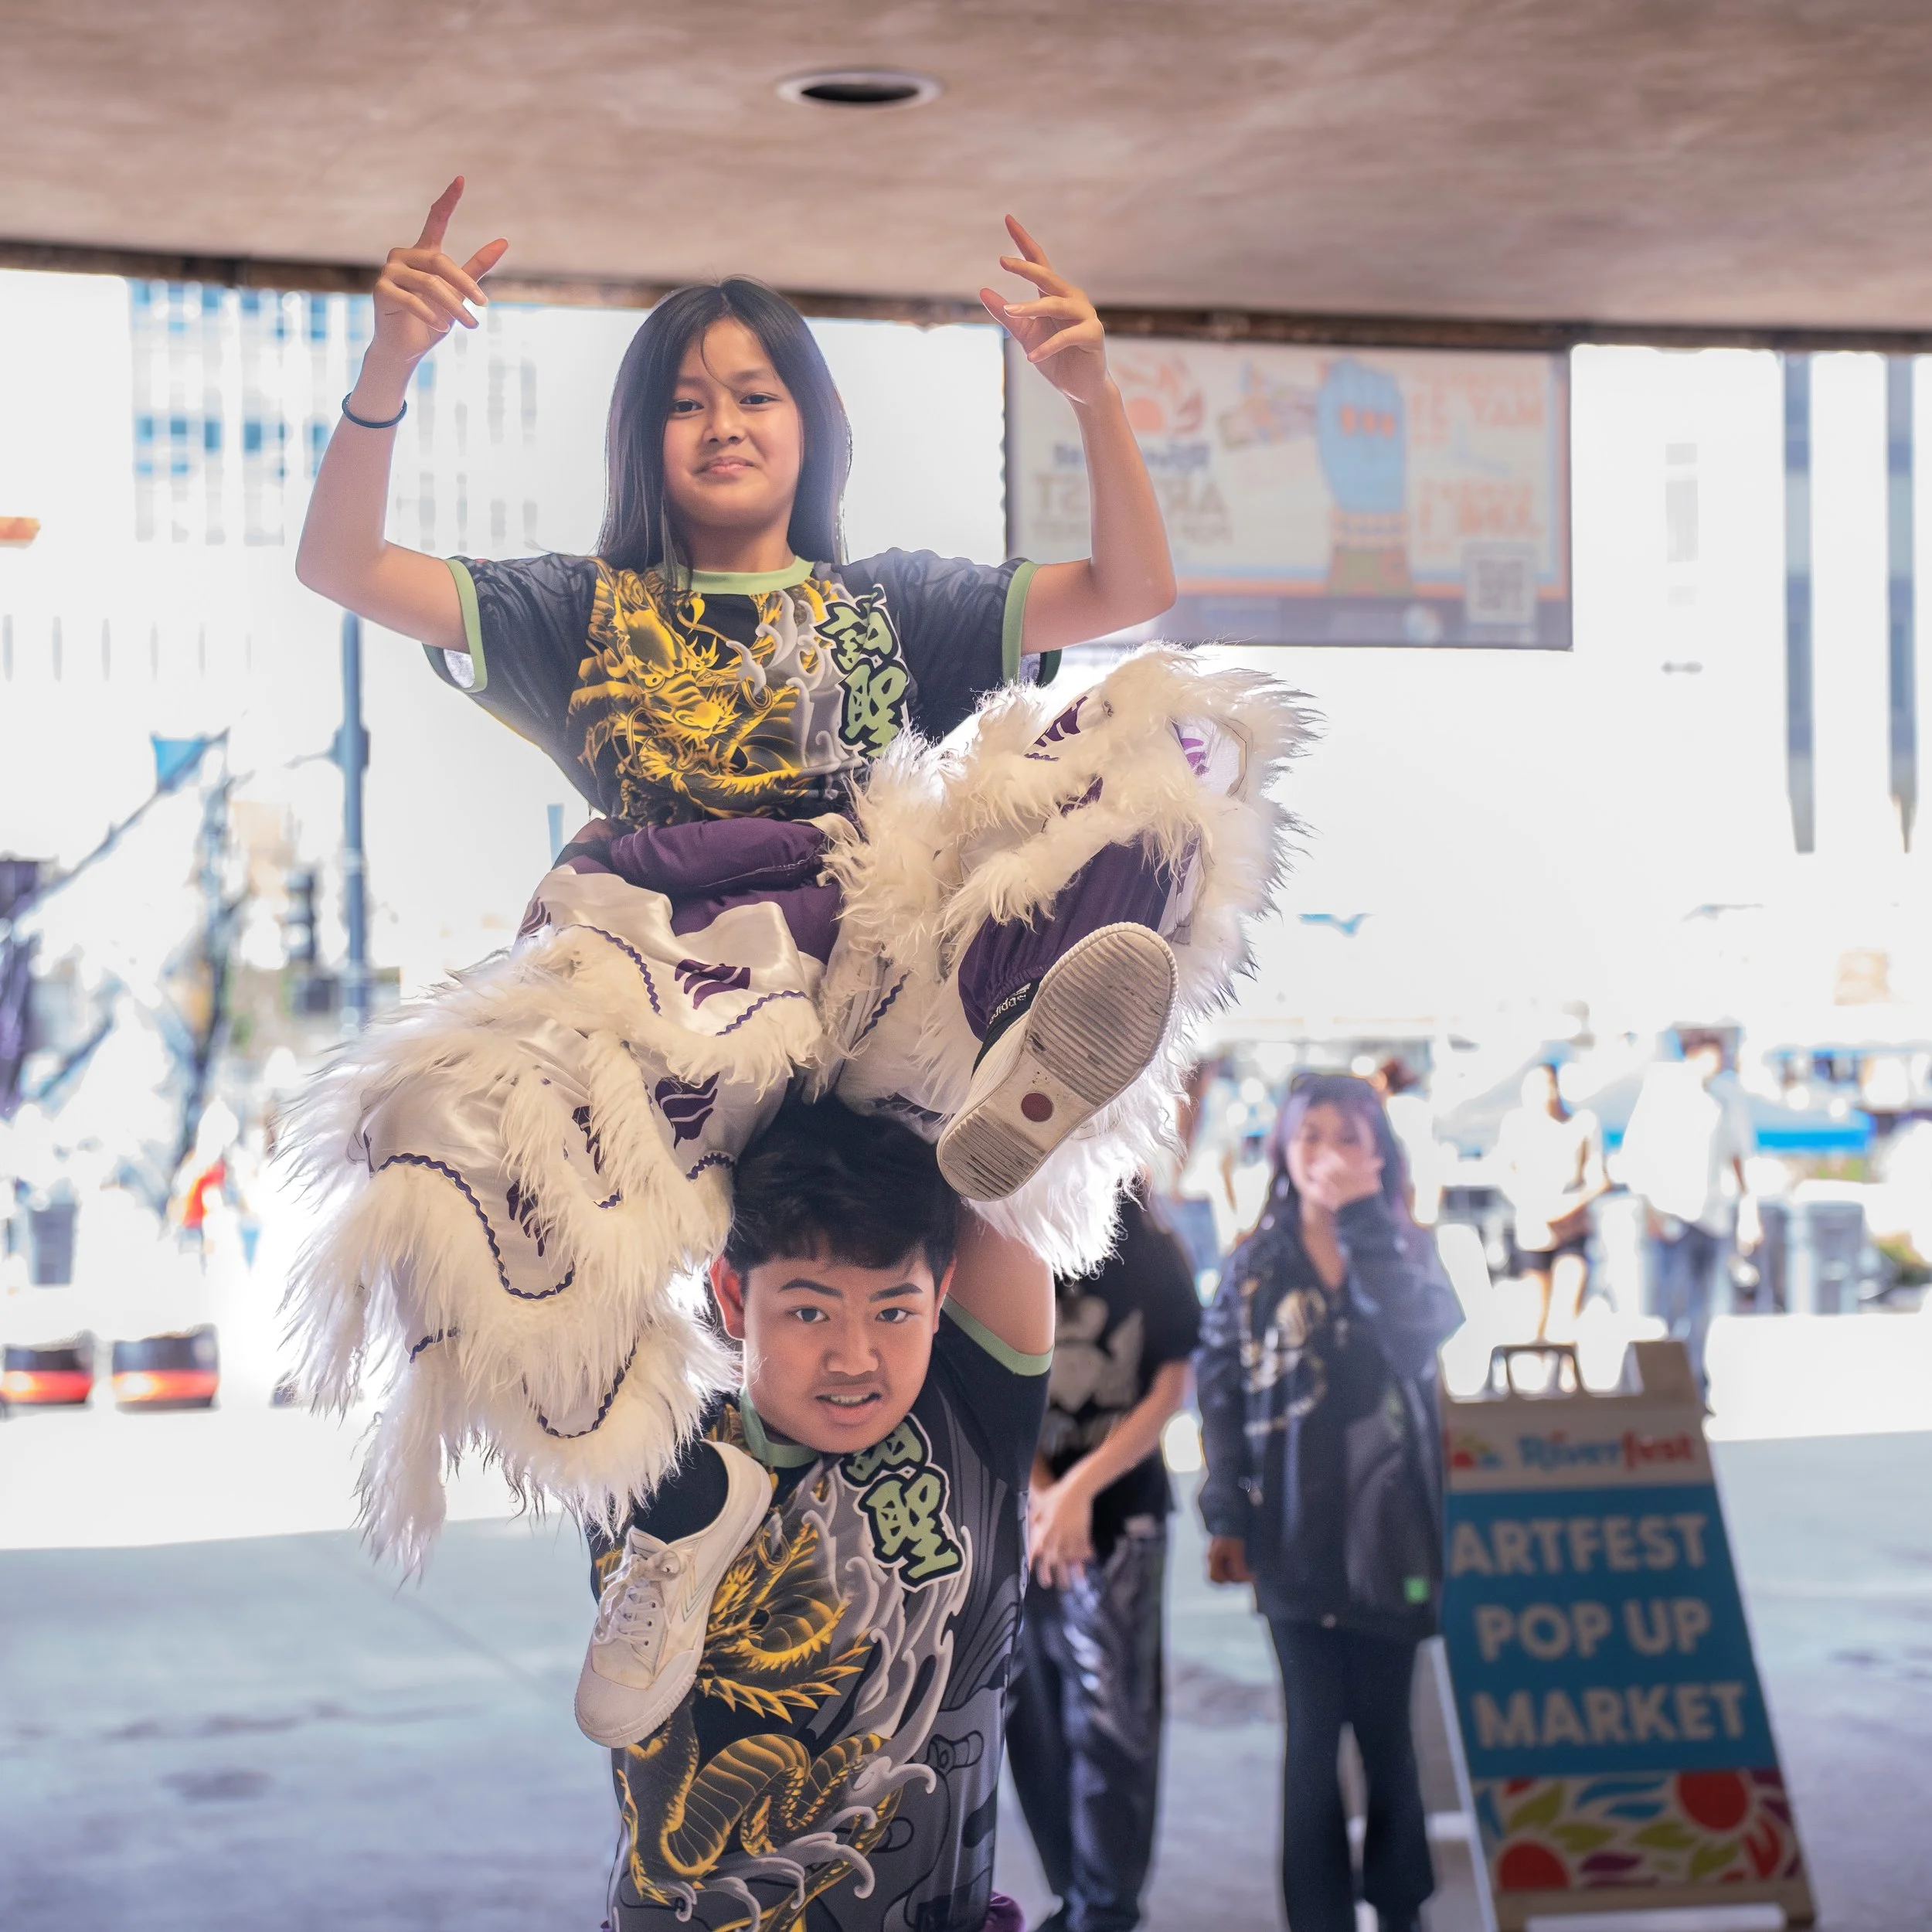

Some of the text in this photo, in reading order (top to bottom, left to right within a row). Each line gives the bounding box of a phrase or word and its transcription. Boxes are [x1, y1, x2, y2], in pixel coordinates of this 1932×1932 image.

[1516, 1429, 1693, 1473] Riverfest
[1451, 1513, 1709, 1576] ARTFEST
[1475, 1597, 1712, 1661] POP UP
[1475, 1682, 1745, 1748] MARKET
